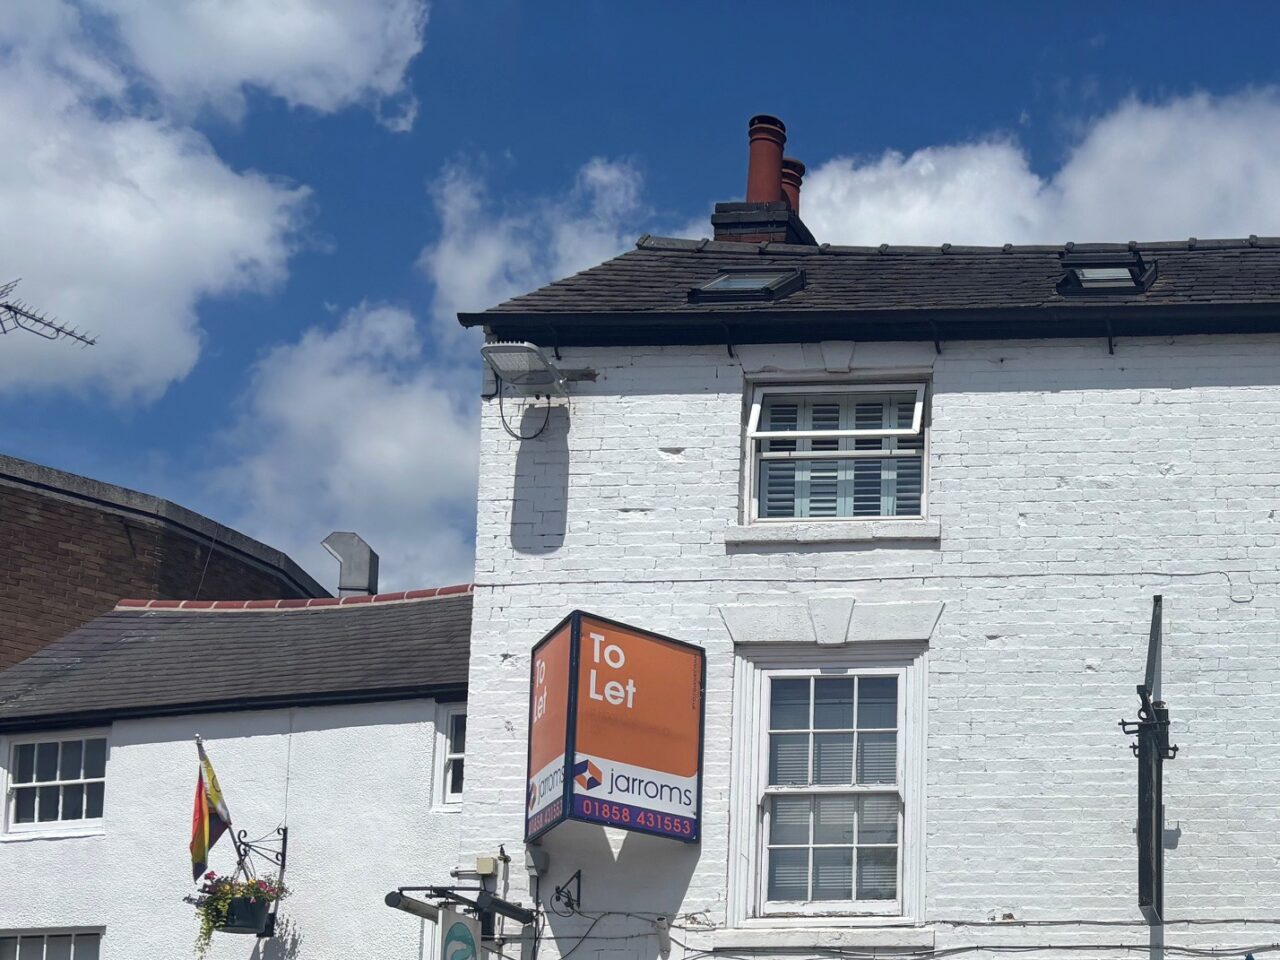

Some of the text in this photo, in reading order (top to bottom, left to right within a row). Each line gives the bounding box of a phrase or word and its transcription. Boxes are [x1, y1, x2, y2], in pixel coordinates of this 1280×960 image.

[590, 632, 626, 669] To
[589, 669, 636, 709] Let
[608, 768, 693, 806] jarroms
[583, 800, 692, 834] 01858 431553
